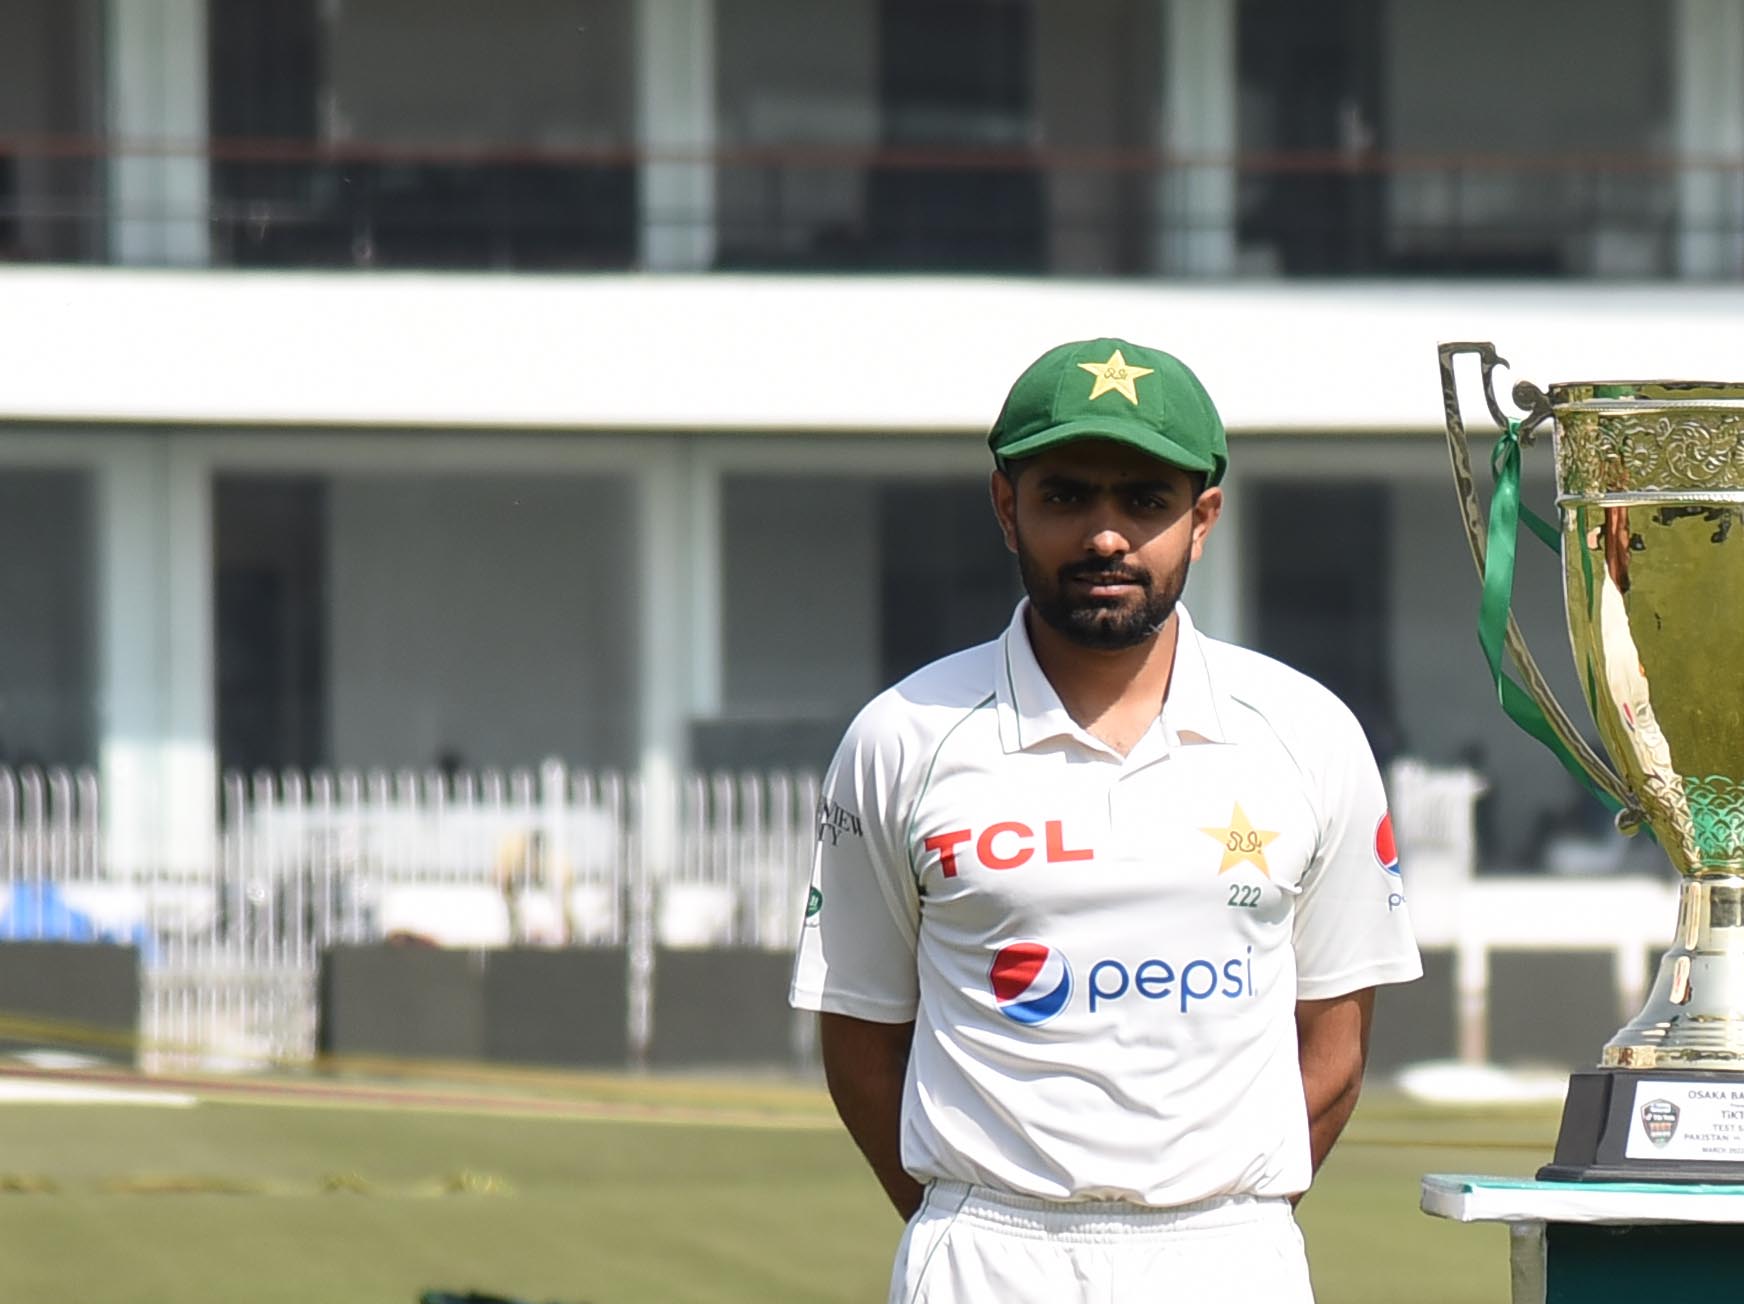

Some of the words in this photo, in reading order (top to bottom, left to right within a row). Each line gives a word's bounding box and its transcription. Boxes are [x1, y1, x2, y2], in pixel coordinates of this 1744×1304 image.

[924, 820, 1095, 879] TCL
[1227, 883, 1262, 908] 222
[1089, 945, 1253, 1013] pepsi
[1688, 1090, 1727, 1100] OSAKA
[1712, 1123, 1736, 1133] TEST
[1684, 1132, 1730, 1142] PAKISTAN
